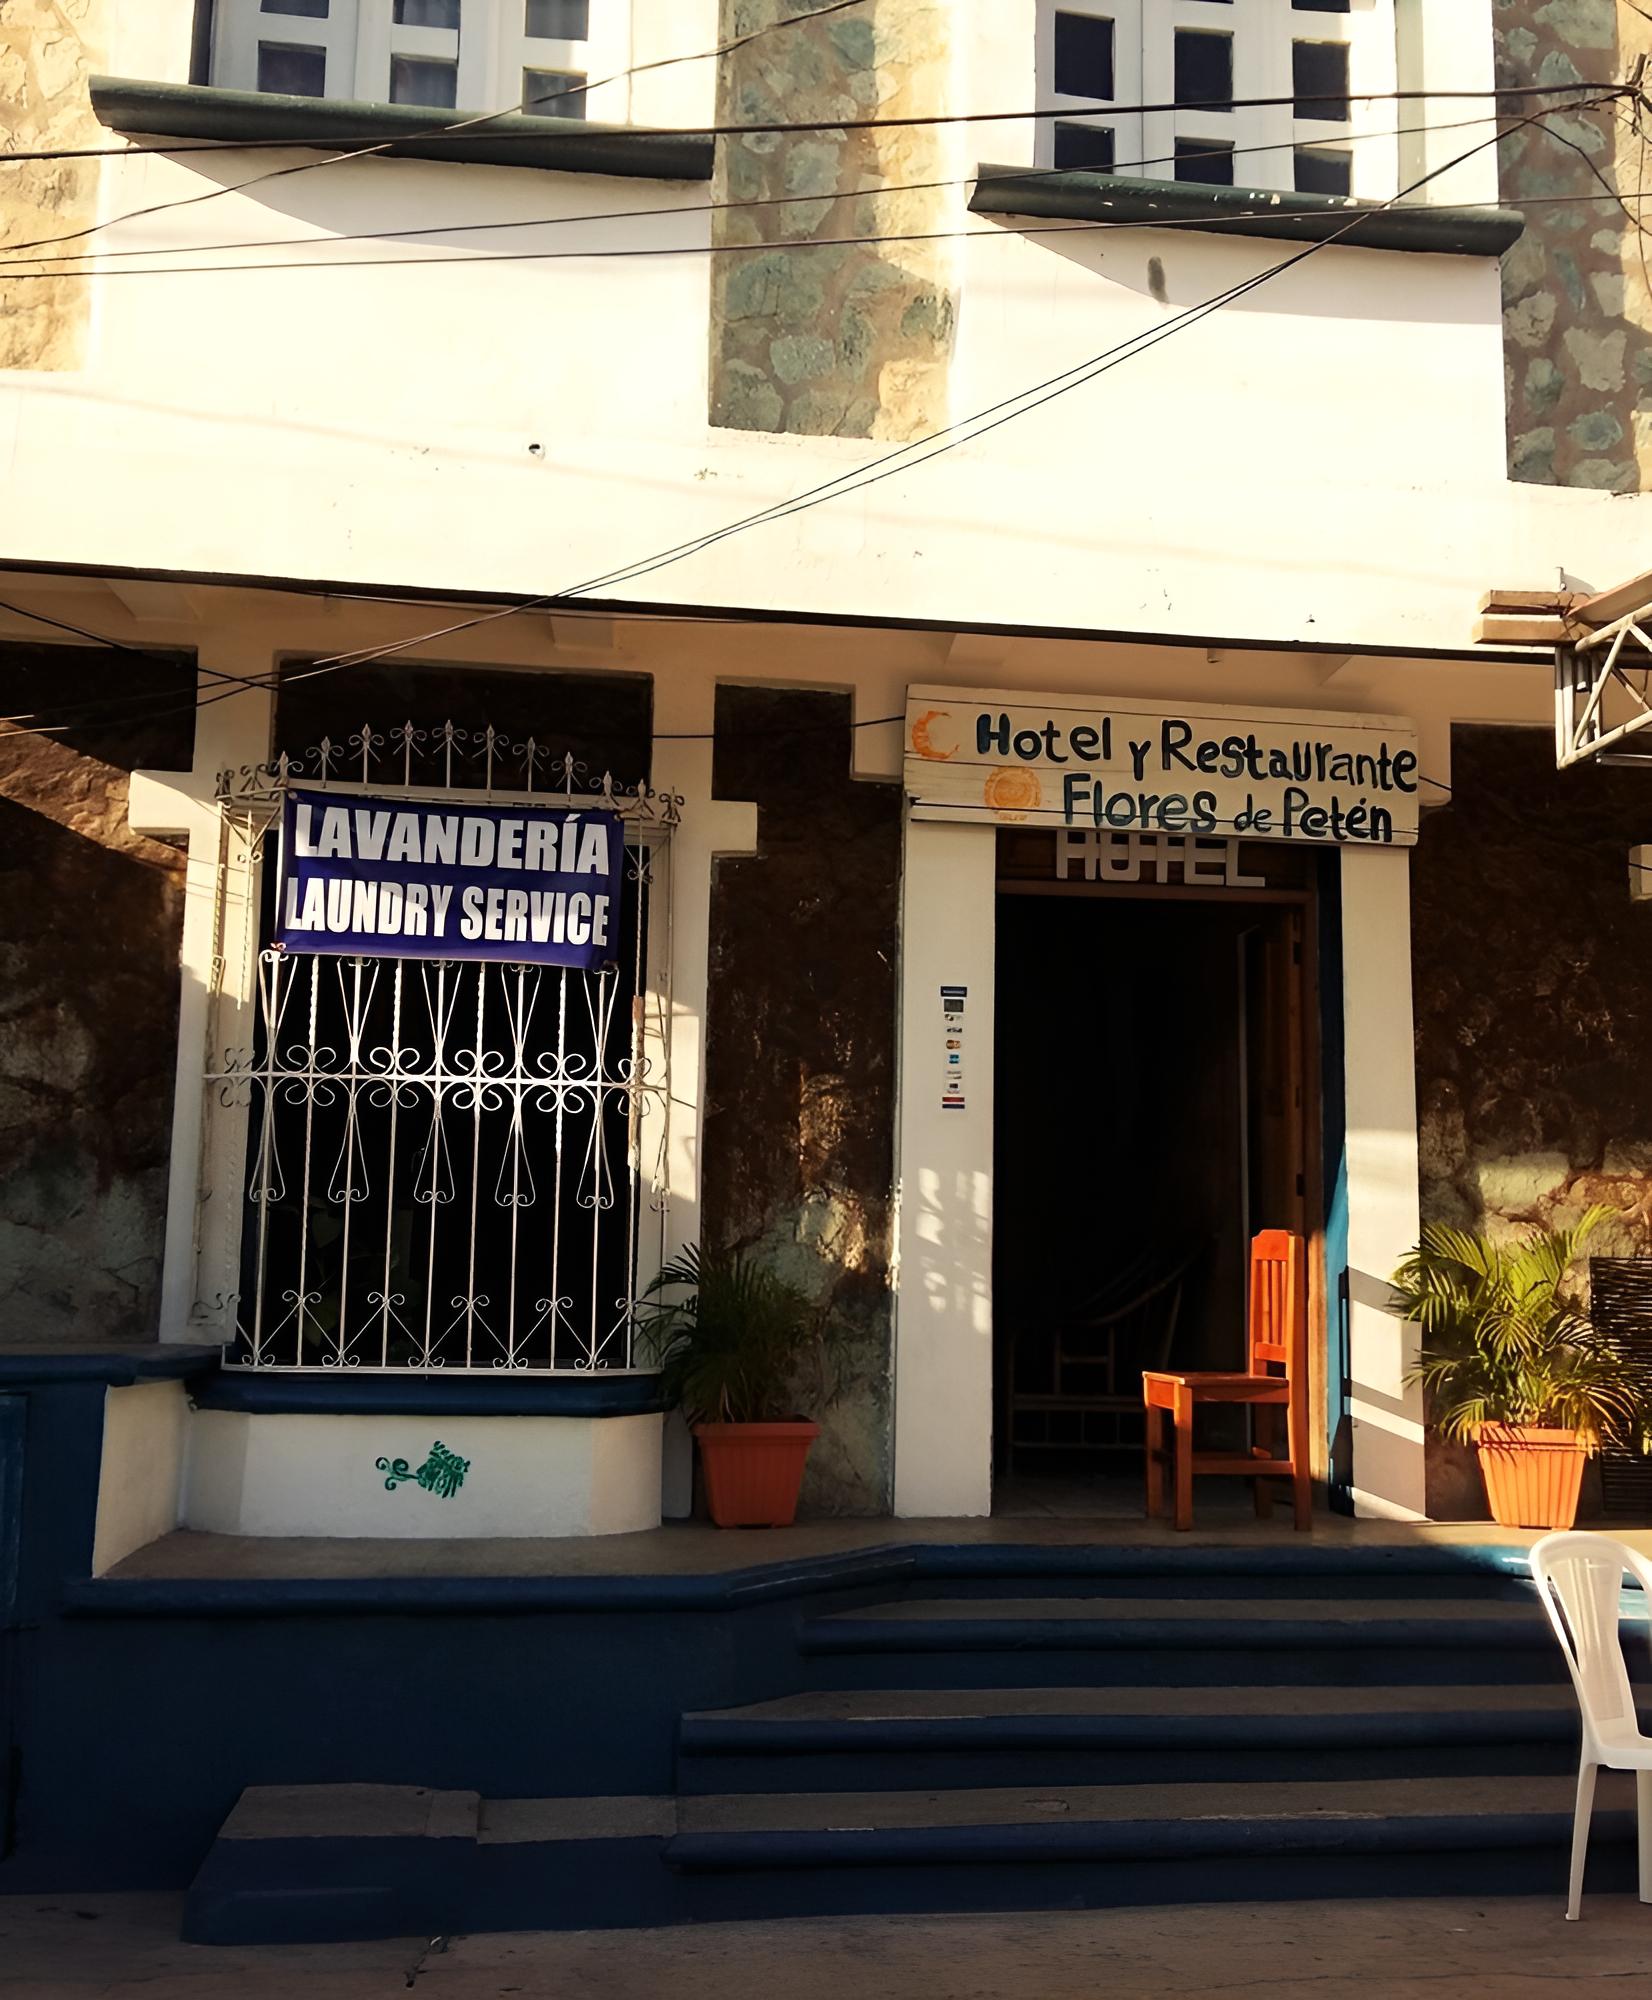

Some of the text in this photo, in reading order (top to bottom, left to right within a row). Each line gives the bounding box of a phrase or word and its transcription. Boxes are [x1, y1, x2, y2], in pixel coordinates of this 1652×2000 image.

[976, 713, 1111, 763] Hotel
[1161, 719, 1417, 793] Restaurante
[295, 804, 609, 875] LAVANDERÍA
[1063, 773, 1392, 842] Flores de Petén
[285, 877, 609, 946] LAUNDRY SERVICE
